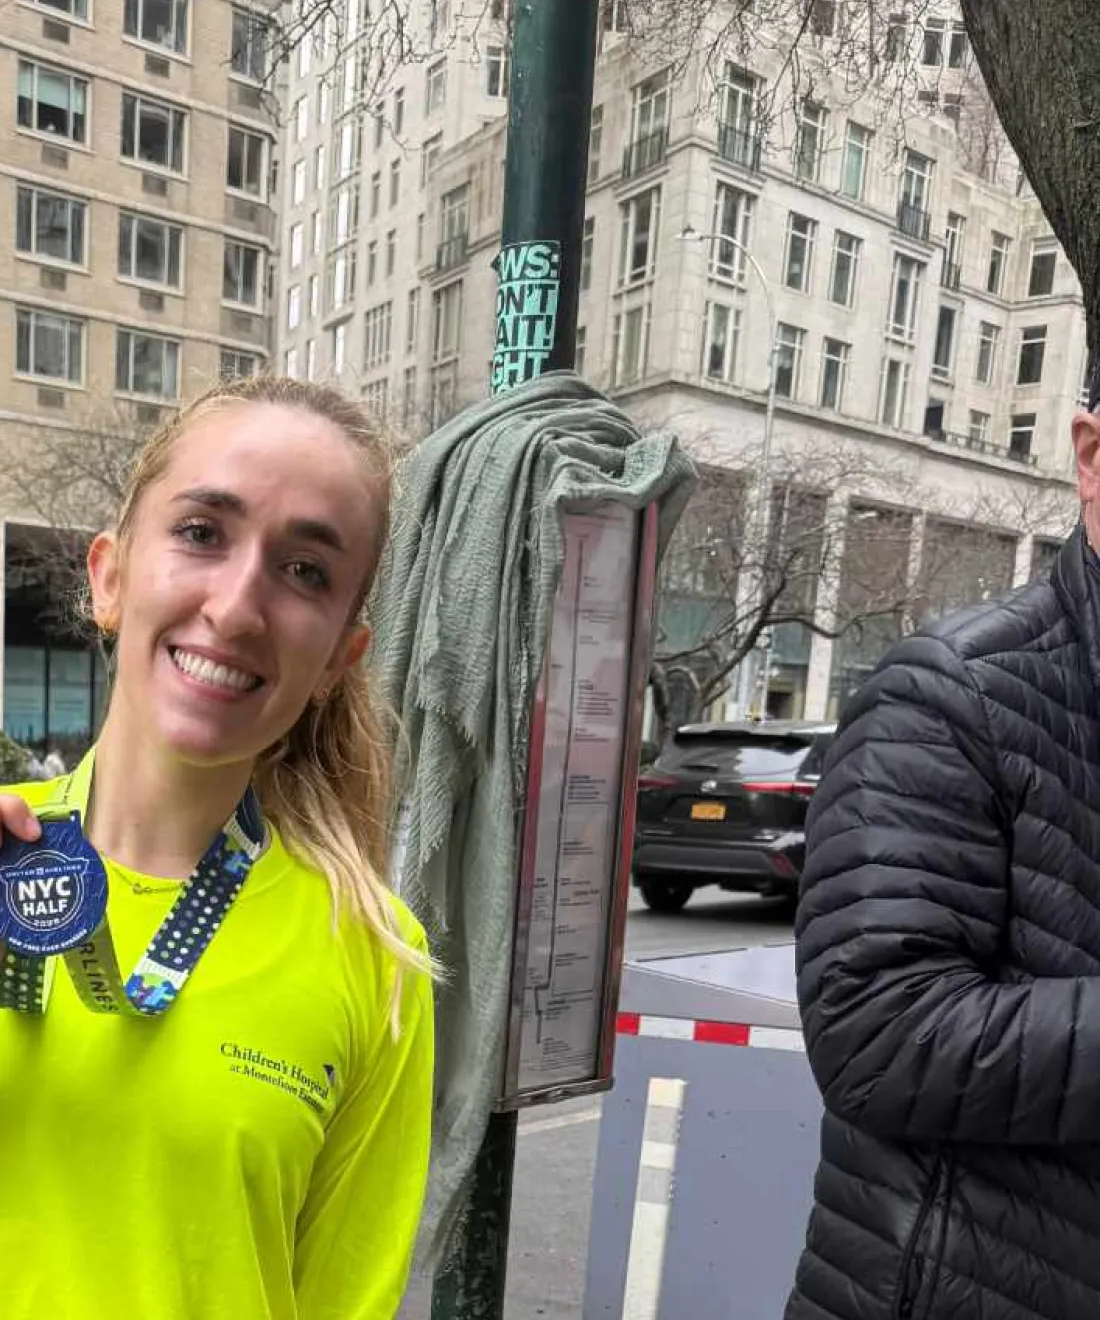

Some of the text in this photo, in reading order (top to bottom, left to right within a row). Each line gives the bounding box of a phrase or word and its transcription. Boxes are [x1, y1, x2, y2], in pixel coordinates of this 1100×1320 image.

[498, 244, 559, 282] WS:
[18, 876, 71, 900] NYC
[22, 899, 68, 916] HALF
[220, 1042, 288, 1075] Children's
